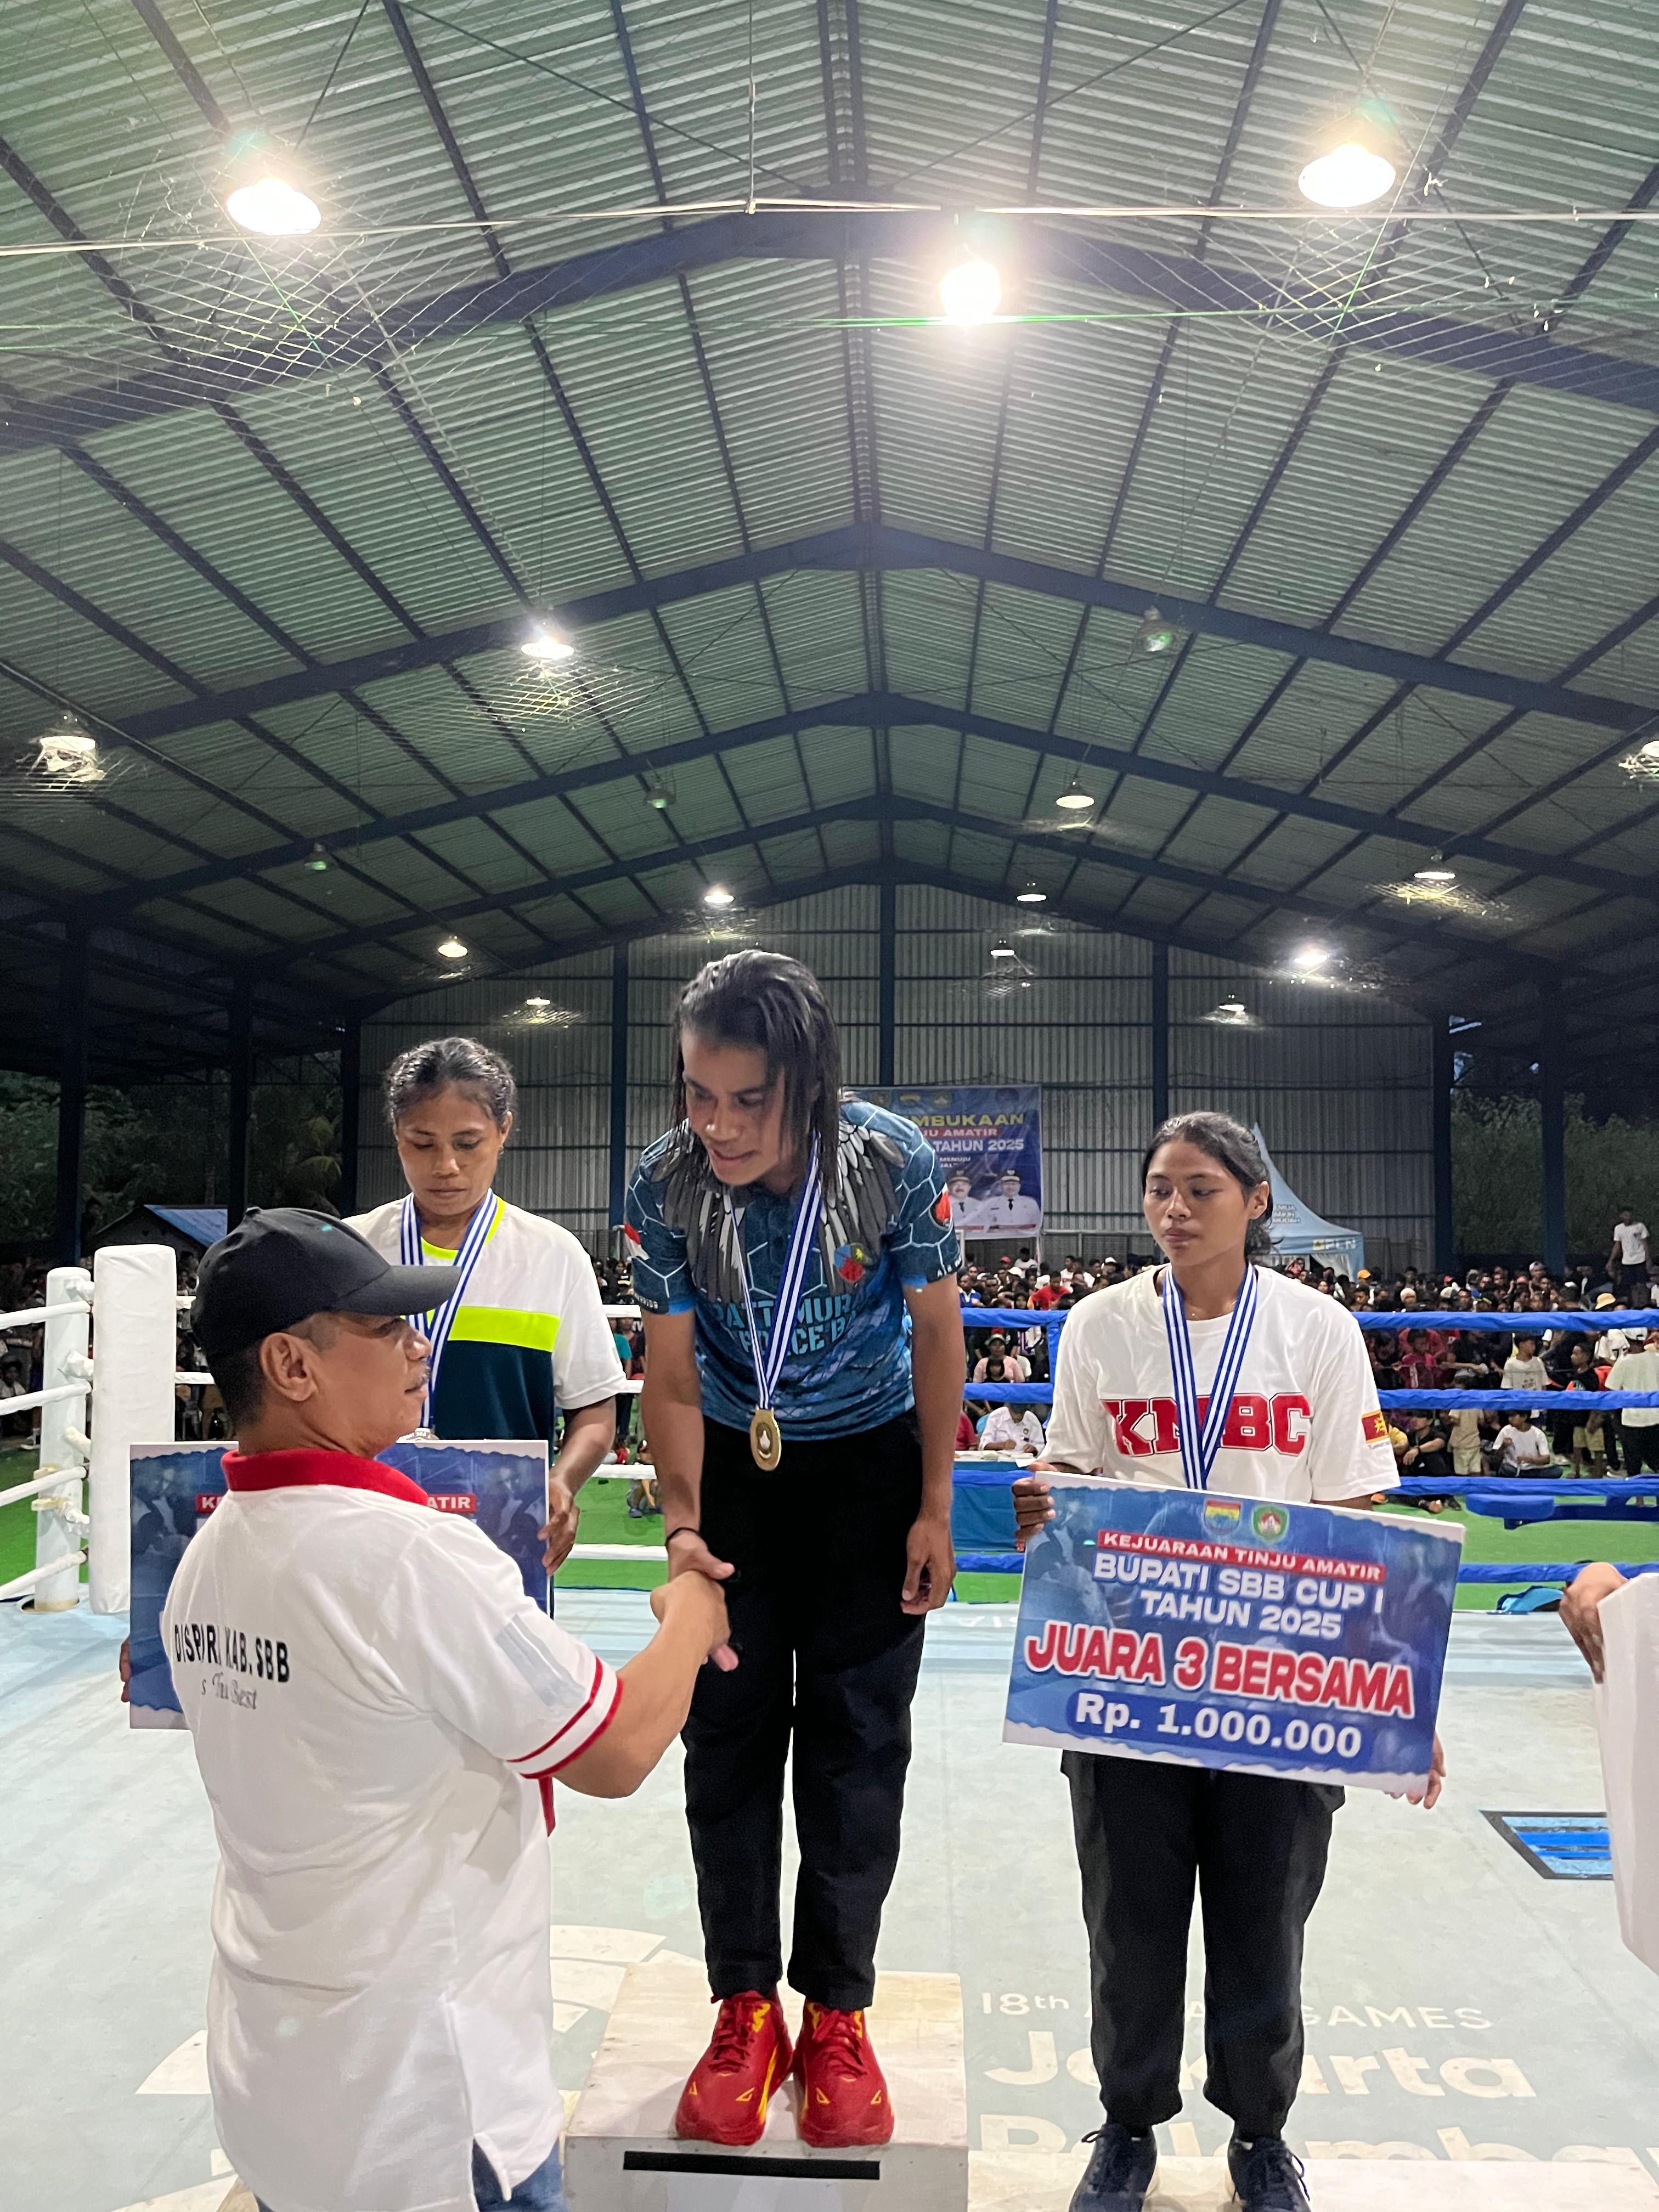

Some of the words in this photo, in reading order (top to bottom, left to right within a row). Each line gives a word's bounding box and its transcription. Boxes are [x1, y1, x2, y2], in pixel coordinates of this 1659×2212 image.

[906, 1114, 1024, 1126] MBUKAAN
[943, 1128, 997, 1137] AMATIR
[933, 1139, 983, 1152] TAHUN
[988, 1138, 1024, 1150] 2025
[427, 1497, 471, 1509] ATIR
[1103, 1532, 1228, 1560] KEJUARAAN
[1234, 1547, 1296, 1569] TINJU
[1302, 1558, 1381, 1581] AMATIR
[1094, 1553, 1210, 1591] BUPATI
[1218, 1567, 1285, 1601] SBB
[1295, 1580, 1365, 1610] CUP
[1140, 1589, 1251, 1628] TAHUN
[1259, 1605, 1342, 1640] 2025
[256, 1636, 290, 1683] SBB
[1025, 1621, 1165, 1686] JUARA
[1174, 1637, 1208, 1691] 3
[1210, 1641, 1415, 1719] BERSAMA
[1075, 1692, 1140, 1735] Rp.
[1157, 1703, 1362, 1758] 1.000.000
[981, 1992, 1070, 2016] 18th
